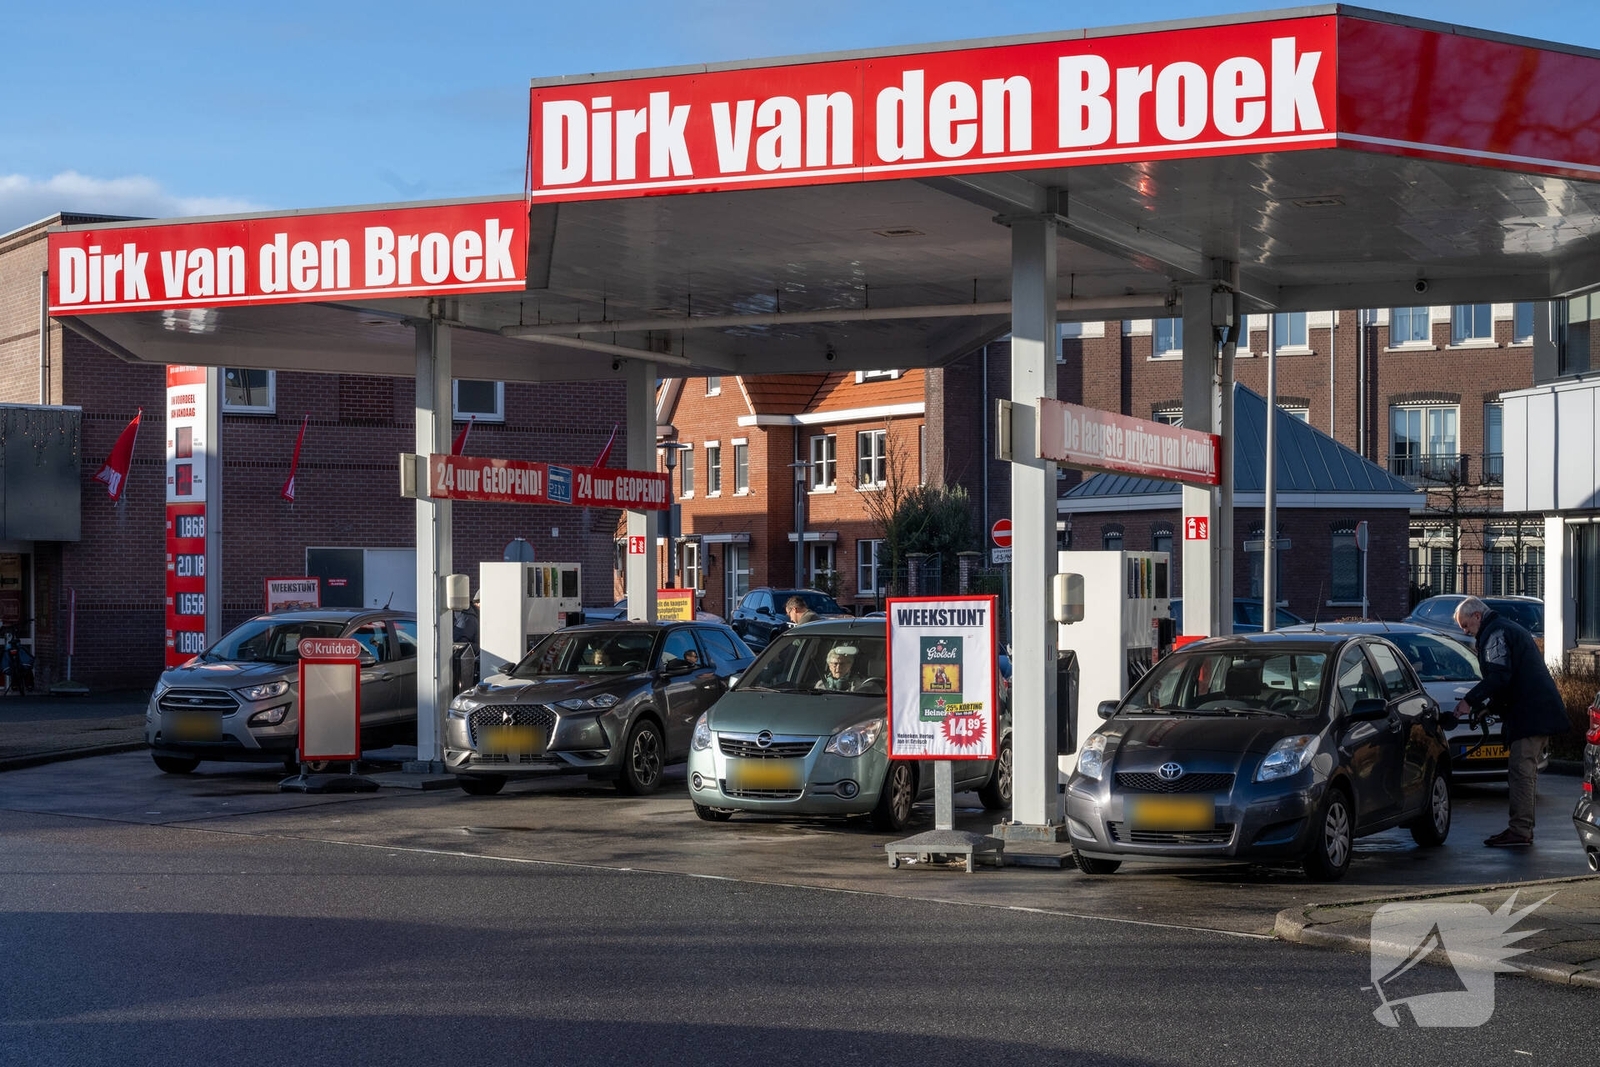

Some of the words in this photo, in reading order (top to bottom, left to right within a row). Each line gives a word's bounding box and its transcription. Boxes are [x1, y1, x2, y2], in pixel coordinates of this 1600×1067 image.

[542, 90, 694, 186] Dirk
[710, 91, 854, 174] van
[875, 69, 1032, 163] den
[1058, 37, 1325, 149] Broek
[58, 243, 151, 305] Dirk
[159, 245, 246, 299] van
[259, 232, 351, 295] den
[364, 218, 517, 288] Broek
[1064, 410, 1079, 450] De
[1081, 413, 1123, 459] laagste
[1125, 425, 1160, 465] prijzen
[1162, 436, 1179, 467] van
[1181, 434, 1216, 475] Katwijk
[437, 462, 455, 491] 24
[456, 468, 481, 493] uur
[483, 465, 542, 496] GEOPEND!
[548, 482, 566, 496] PIN
[577, 473, 592, 499] 24
[594, 478, 614, 501] uur
[615, 476, 665, 503] GEOPEND!
[180, 515, 205, 538] 1.868
[271, 582, 317, 593] WEEKSTUNT
[180, 593, 205, 615] 1.658
[897, 608, 986, 626] WEEKSTUNT
[180, 632, 205, 653] 1.808
[315, 642, 357, 655] Kruidvat
[926, 646, 957, 660] Grolsch
